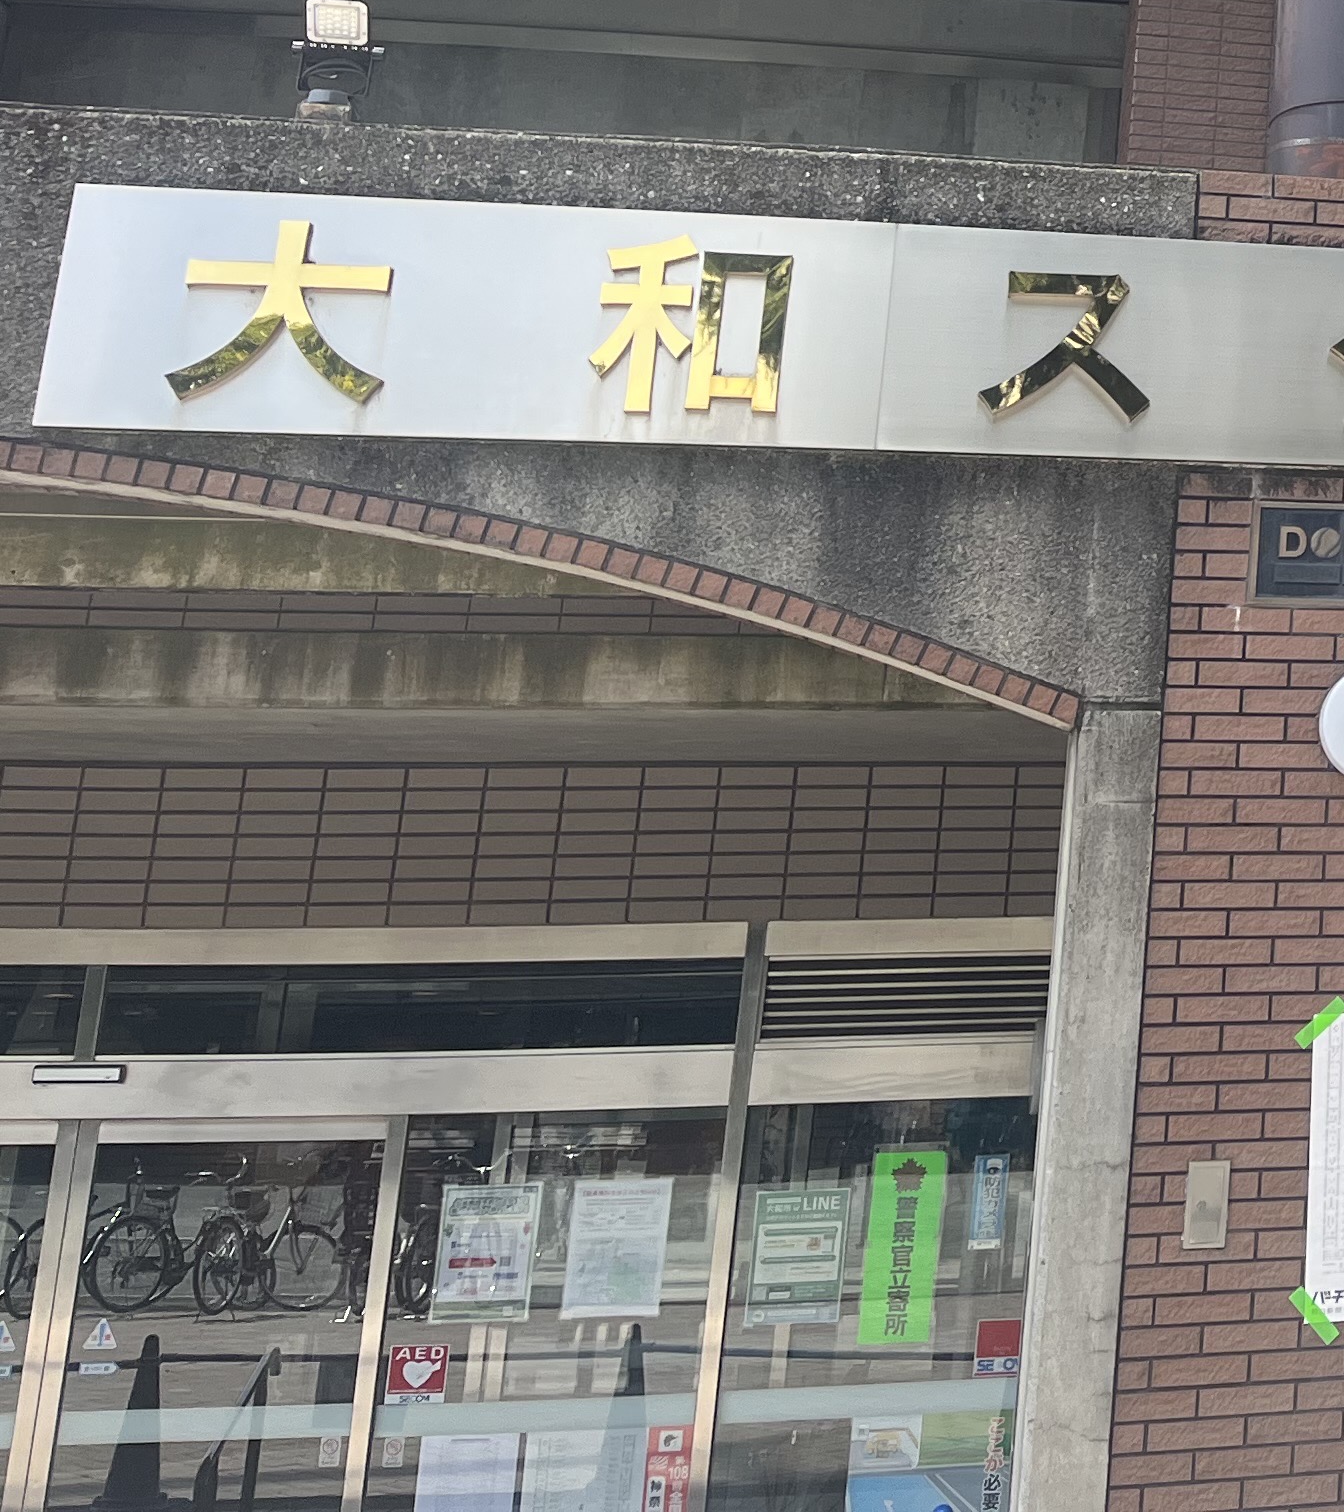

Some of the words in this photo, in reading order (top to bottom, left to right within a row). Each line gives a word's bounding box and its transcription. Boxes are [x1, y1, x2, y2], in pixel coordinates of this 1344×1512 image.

[803, 1196, 841, 1211] LINE
[884, 1196, 918, 1337] 警察官立寄所
[395, 1346, 444, 1361] AED
